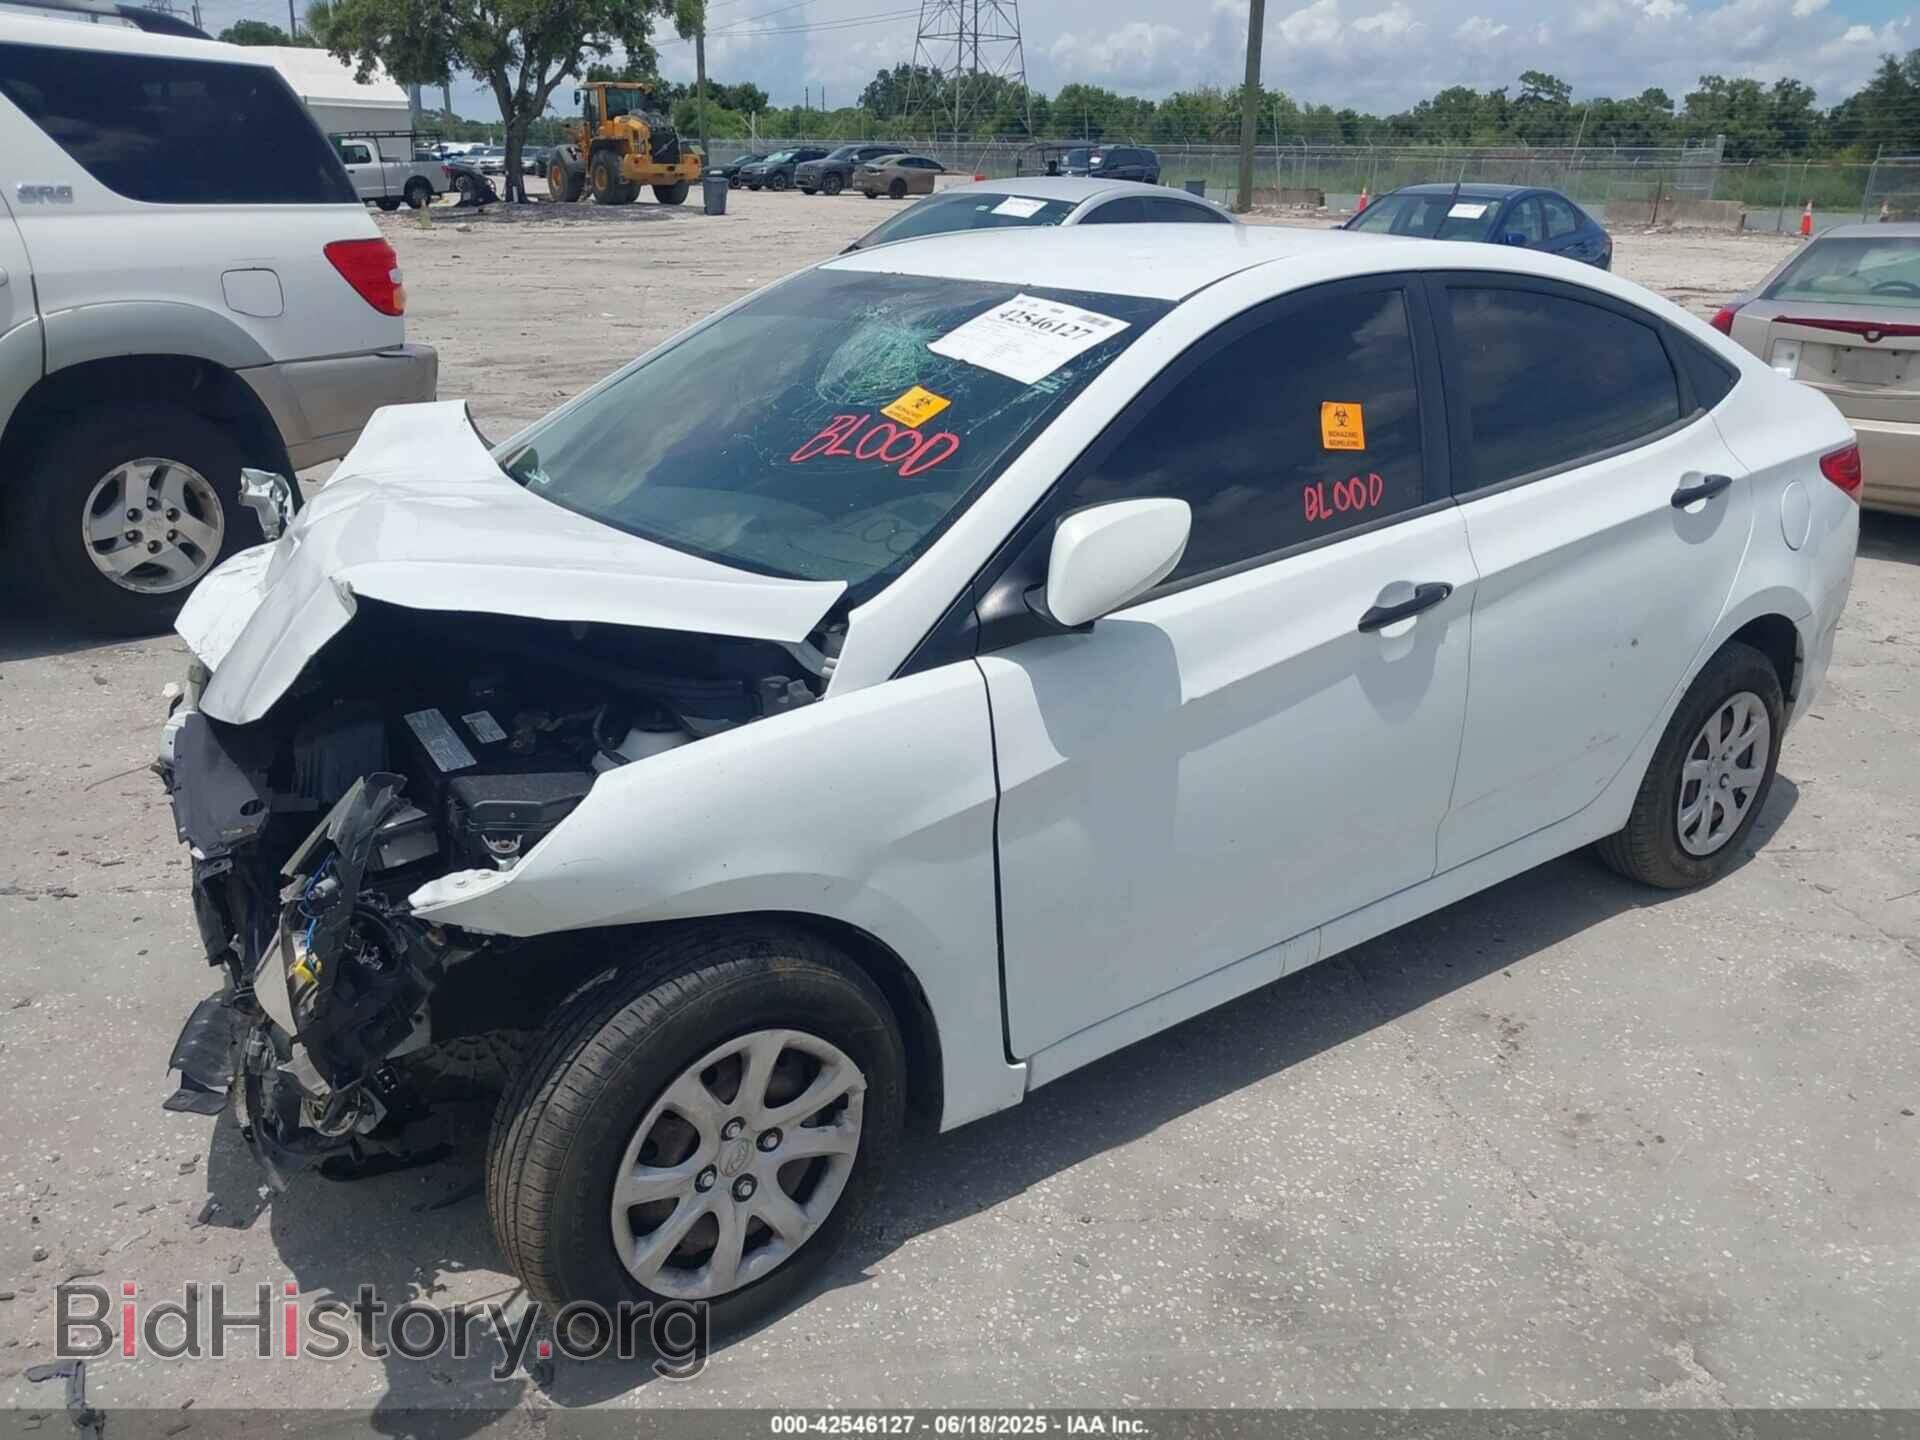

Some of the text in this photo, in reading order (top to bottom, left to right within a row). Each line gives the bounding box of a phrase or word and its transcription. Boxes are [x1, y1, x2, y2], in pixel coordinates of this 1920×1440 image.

[999, 309, 1093, 339] 42546127
[789, 414, 960, 476] BLOOD
[1304, 473, 1383, 521] BLOOD
